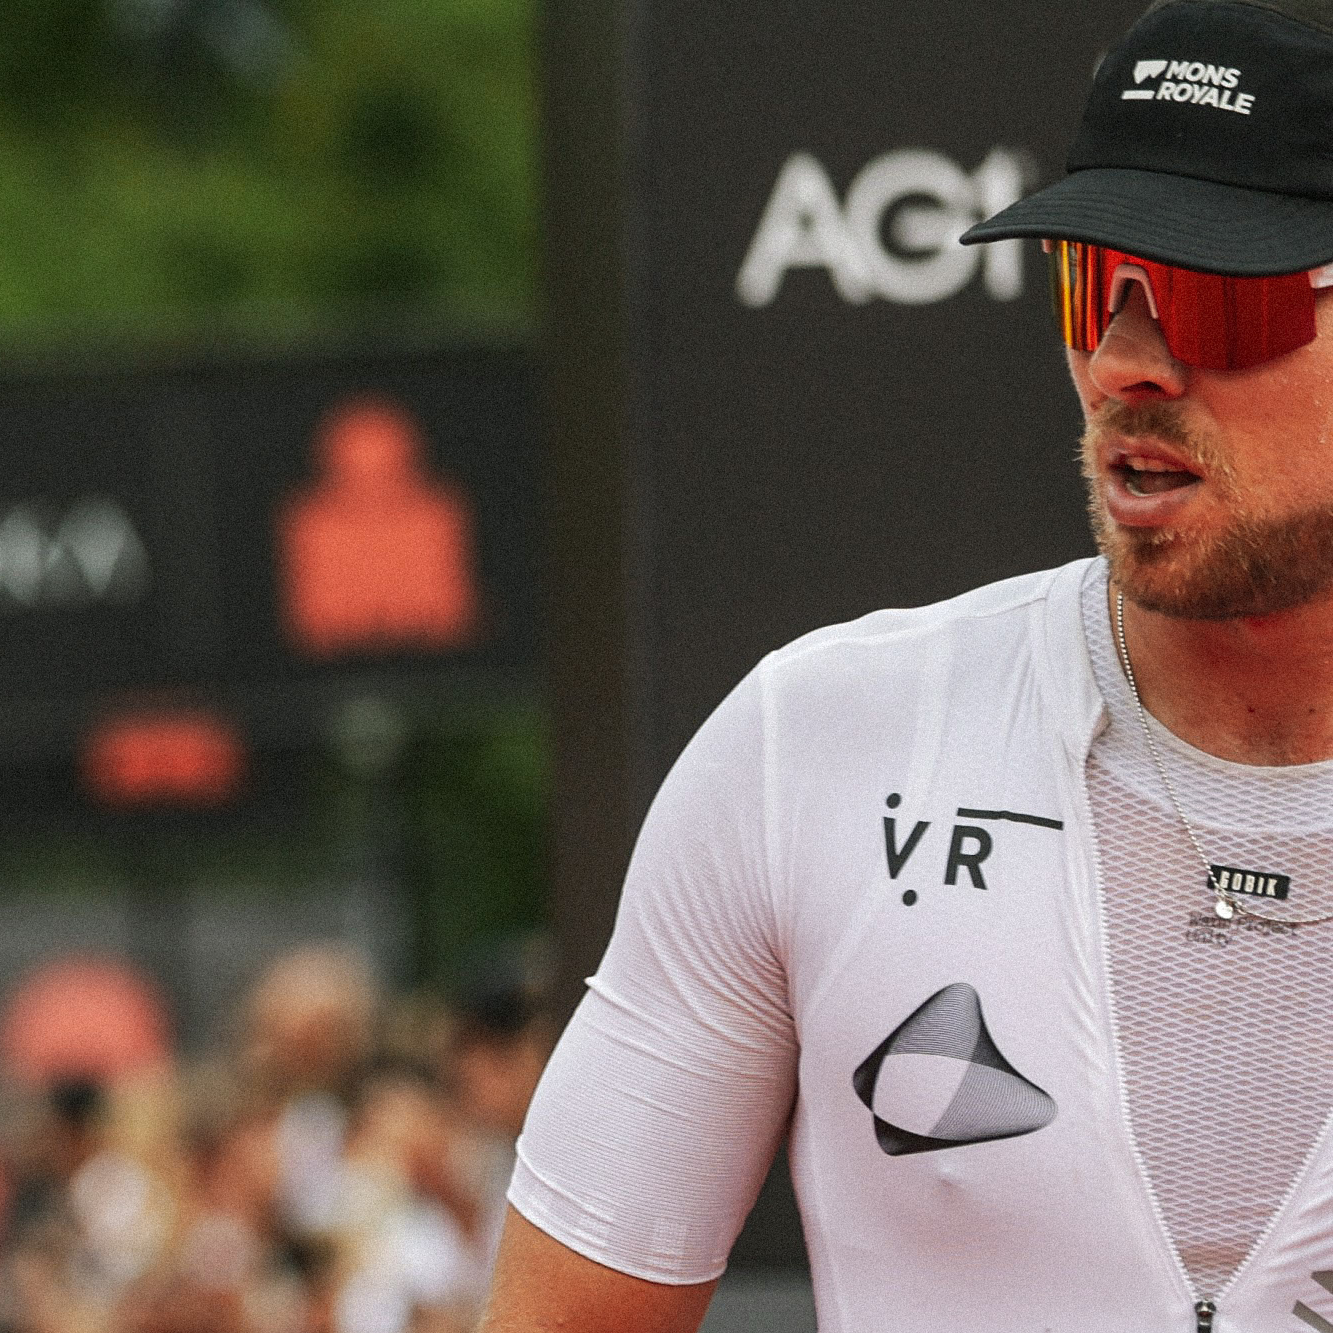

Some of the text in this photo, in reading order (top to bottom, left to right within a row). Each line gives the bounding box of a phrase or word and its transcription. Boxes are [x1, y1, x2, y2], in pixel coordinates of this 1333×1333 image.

[1165, 60, 1242, 89] MONS
[1155, 81, 1256, 115] ROYALE
[1219, 870, 1278, 897] GOBIK
